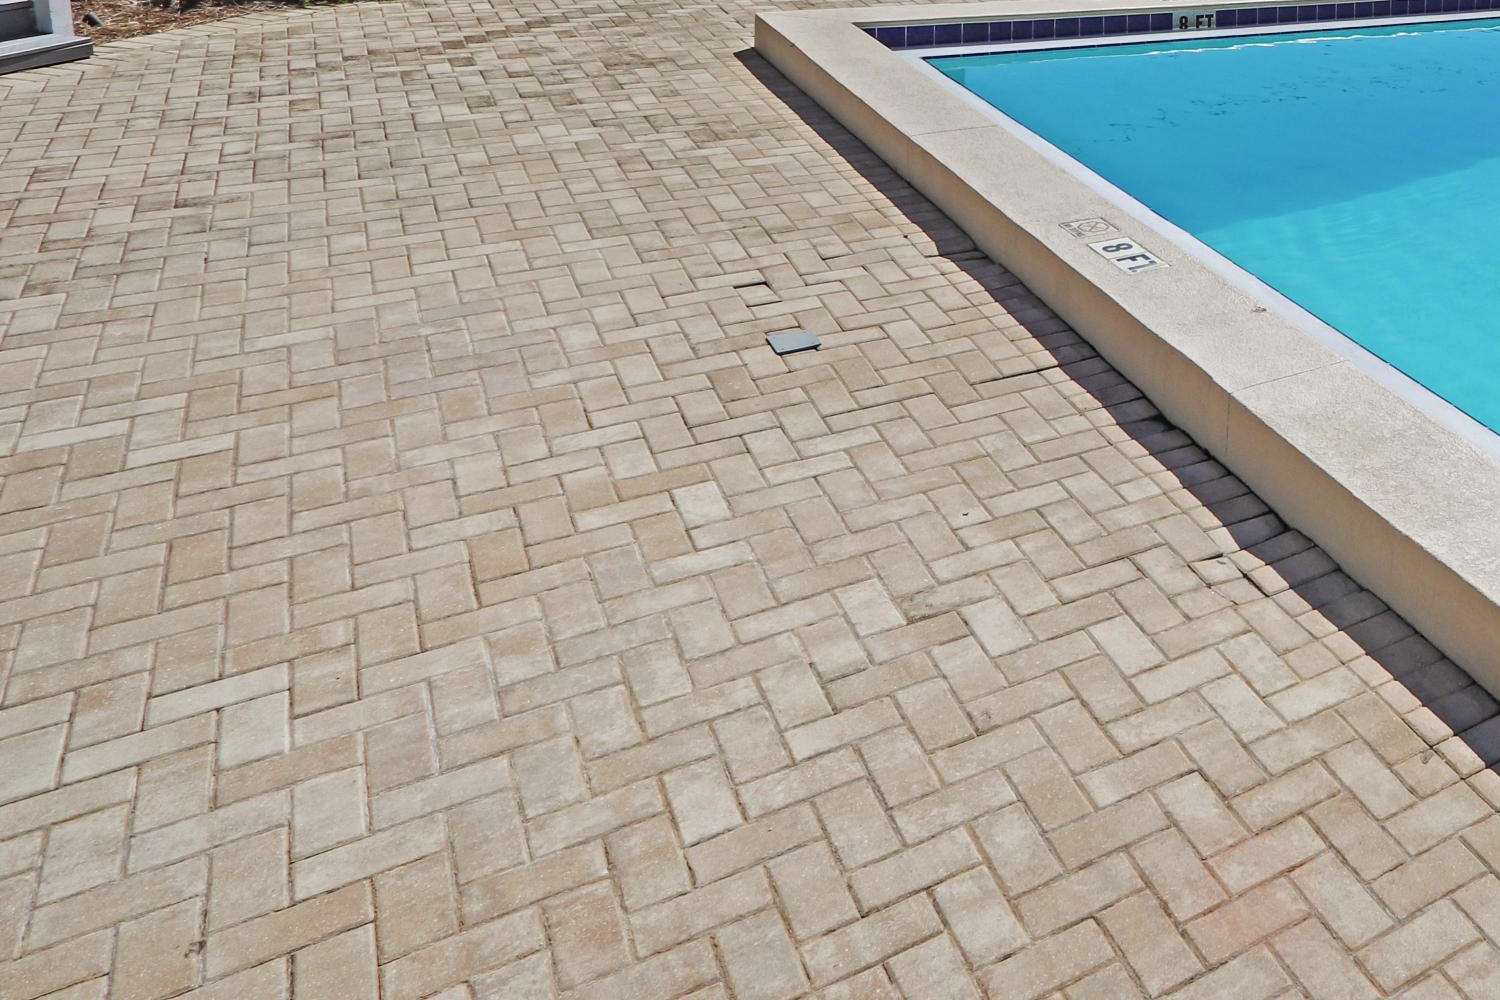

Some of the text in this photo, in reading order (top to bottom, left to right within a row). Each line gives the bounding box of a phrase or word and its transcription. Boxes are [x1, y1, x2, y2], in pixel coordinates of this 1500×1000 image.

[1179, 14, 1214, 29] 8 FT
[1102, 242, 1133, 253] 8
